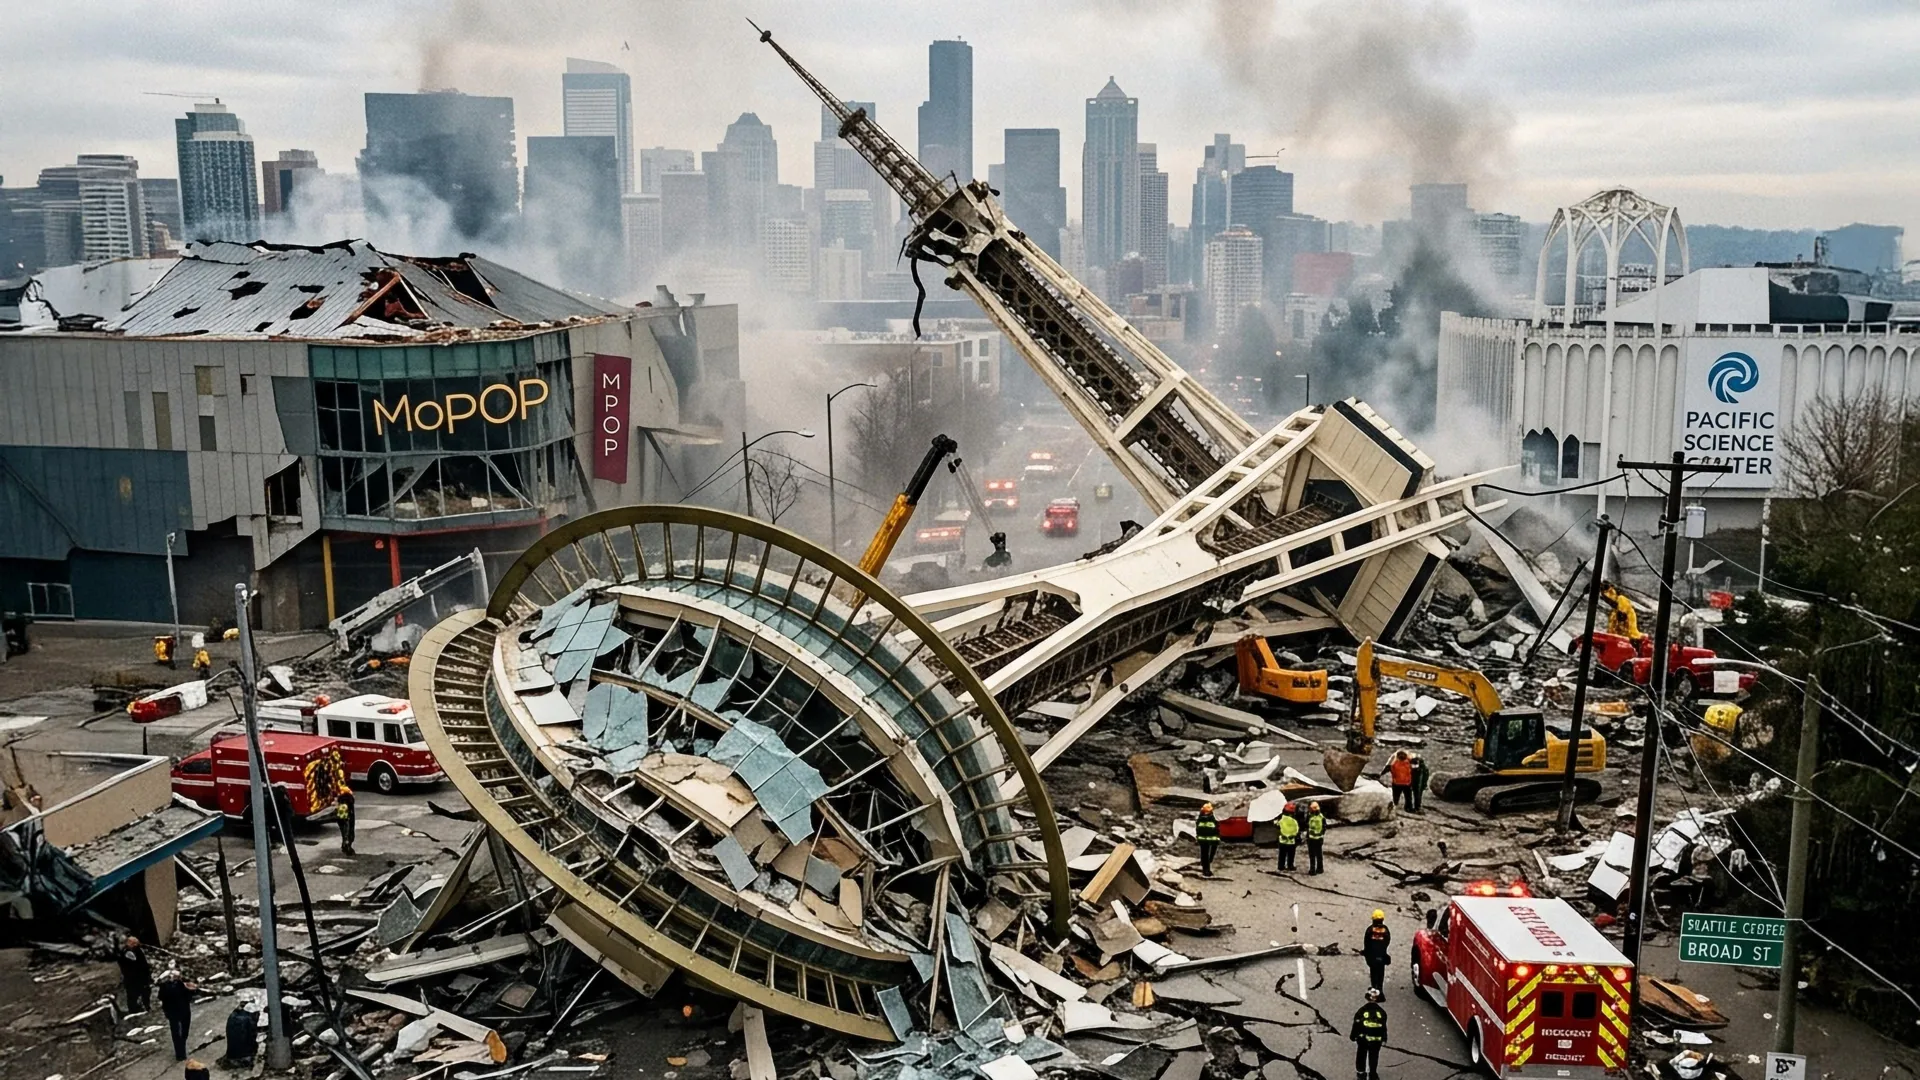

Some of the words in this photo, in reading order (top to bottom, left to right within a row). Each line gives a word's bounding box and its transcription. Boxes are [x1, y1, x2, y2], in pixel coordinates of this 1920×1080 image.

[373, 378, 549, 436] MoPOP
[603, 373, 621, 457] MPOP
[1686, 411, 1775, 430] PACIFIC
[1684, 434, 1775, 452] SCIENCE
[1688, 942, 1742, 960] BROAD
[1753, 946, 1771, 961] ST
